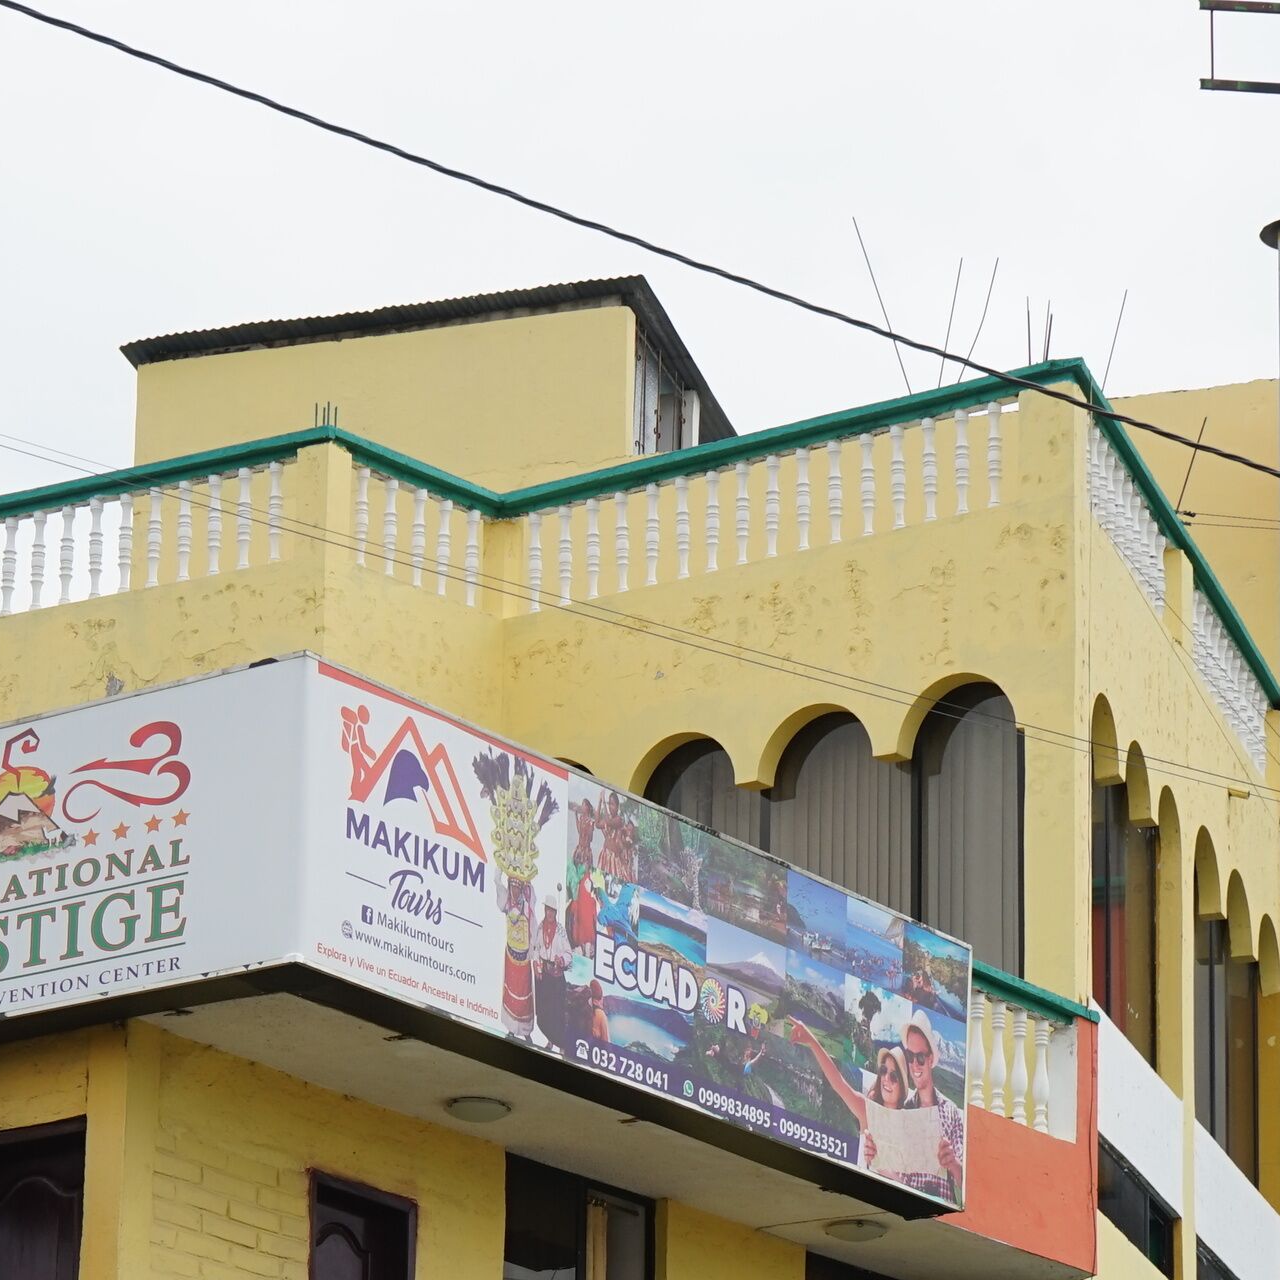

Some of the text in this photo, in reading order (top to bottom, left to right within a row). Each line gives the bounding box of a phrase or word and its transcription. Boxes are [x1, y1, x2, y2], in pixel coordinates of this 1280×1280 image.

[346, 807, 486, 893] MAKIKUM
[389, 869, 442, 925] Tours
[355, 930, 476, 984] www.makikumtours.com
[377, 912, 454, 954] Makikumtours
[98, 956, 181, 986] CENTER
[317, 943, 347, 964] Explora
[357, 957, 374, 973] Vive
[377, 967, 386, 977] un
[388, 969, 420, 989] Ecuador
[421, 982, 458, 1004] Ancestral
[466, 997, 498, 1020] Indómito
[595, 933, 748, 1035] ECUADOR
[592, 1048, 669, 1090] 032 728 041
[699, 1087, 771, 1128] 0999834895
[779, 1118, 847, 1158] 0999233521
